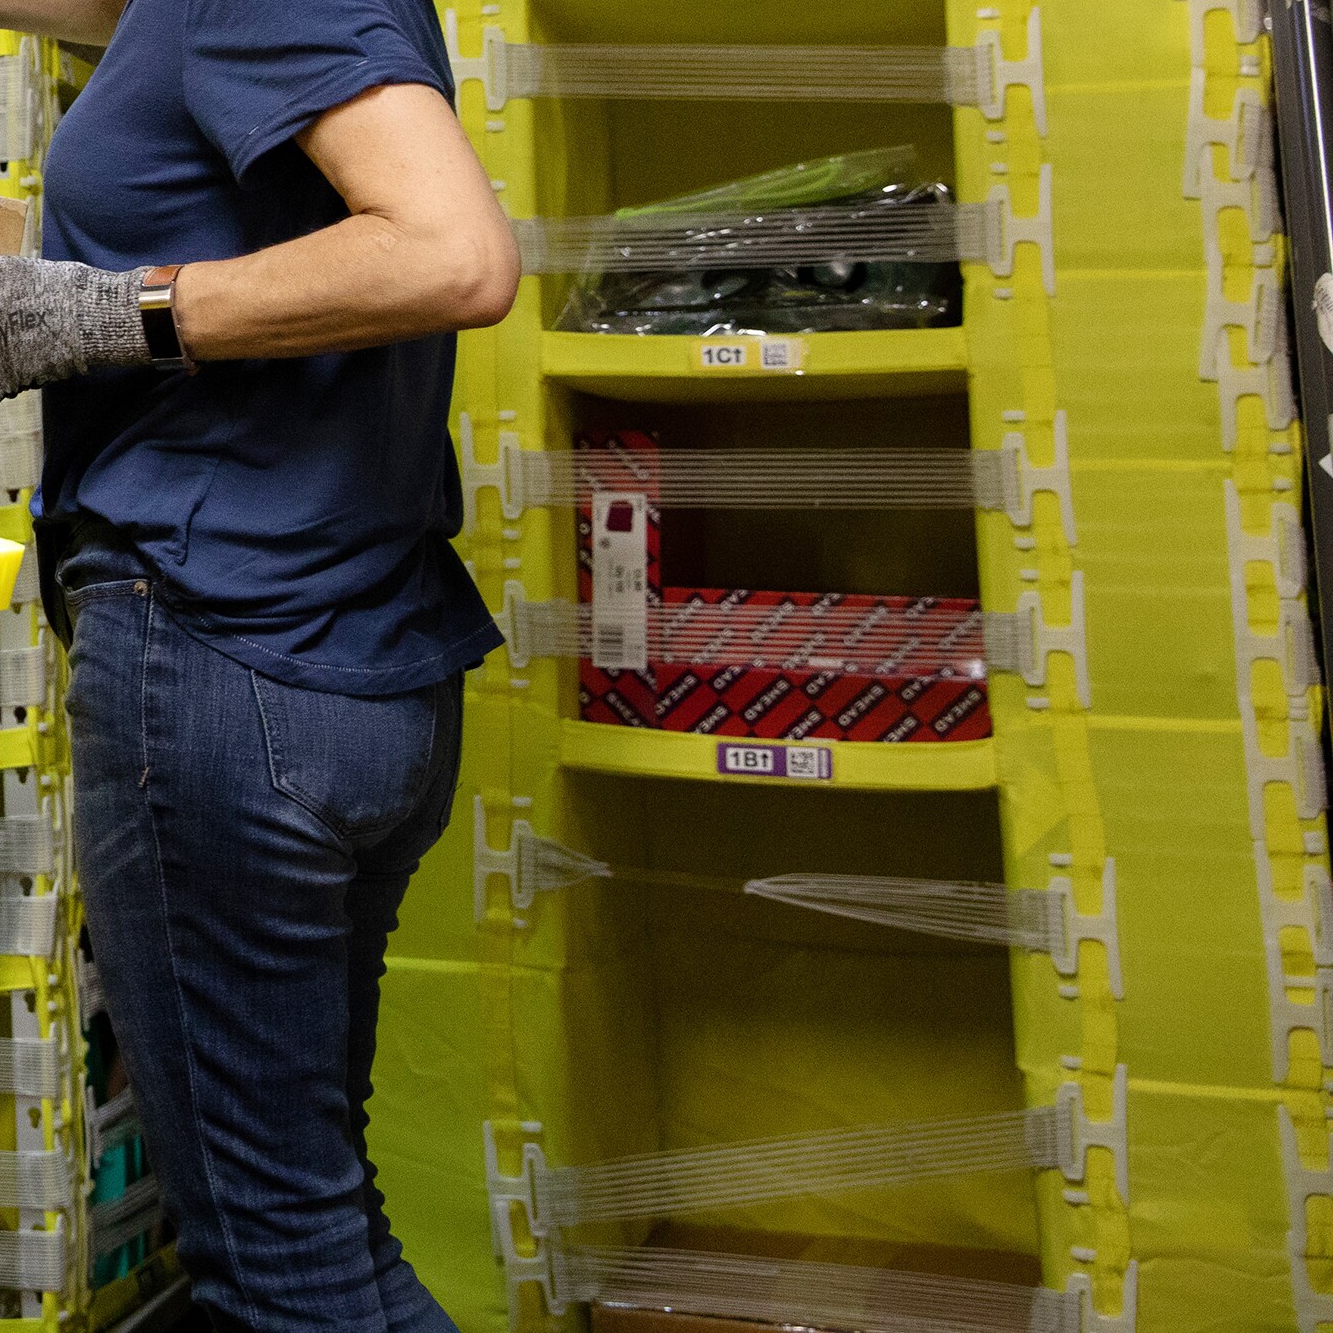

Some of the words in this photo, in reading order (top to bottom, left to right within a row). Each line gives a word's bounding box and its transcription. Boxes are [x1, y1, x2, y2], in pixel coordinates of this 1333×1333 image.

[704, 347, 731, 364] 1C
[742, 677, 791, 723] SMEAD
[836, 683, 885, 729] SMEAD
[932, 687, 982, 734] SMEAD
[728, 750, 759, 768] 1B
